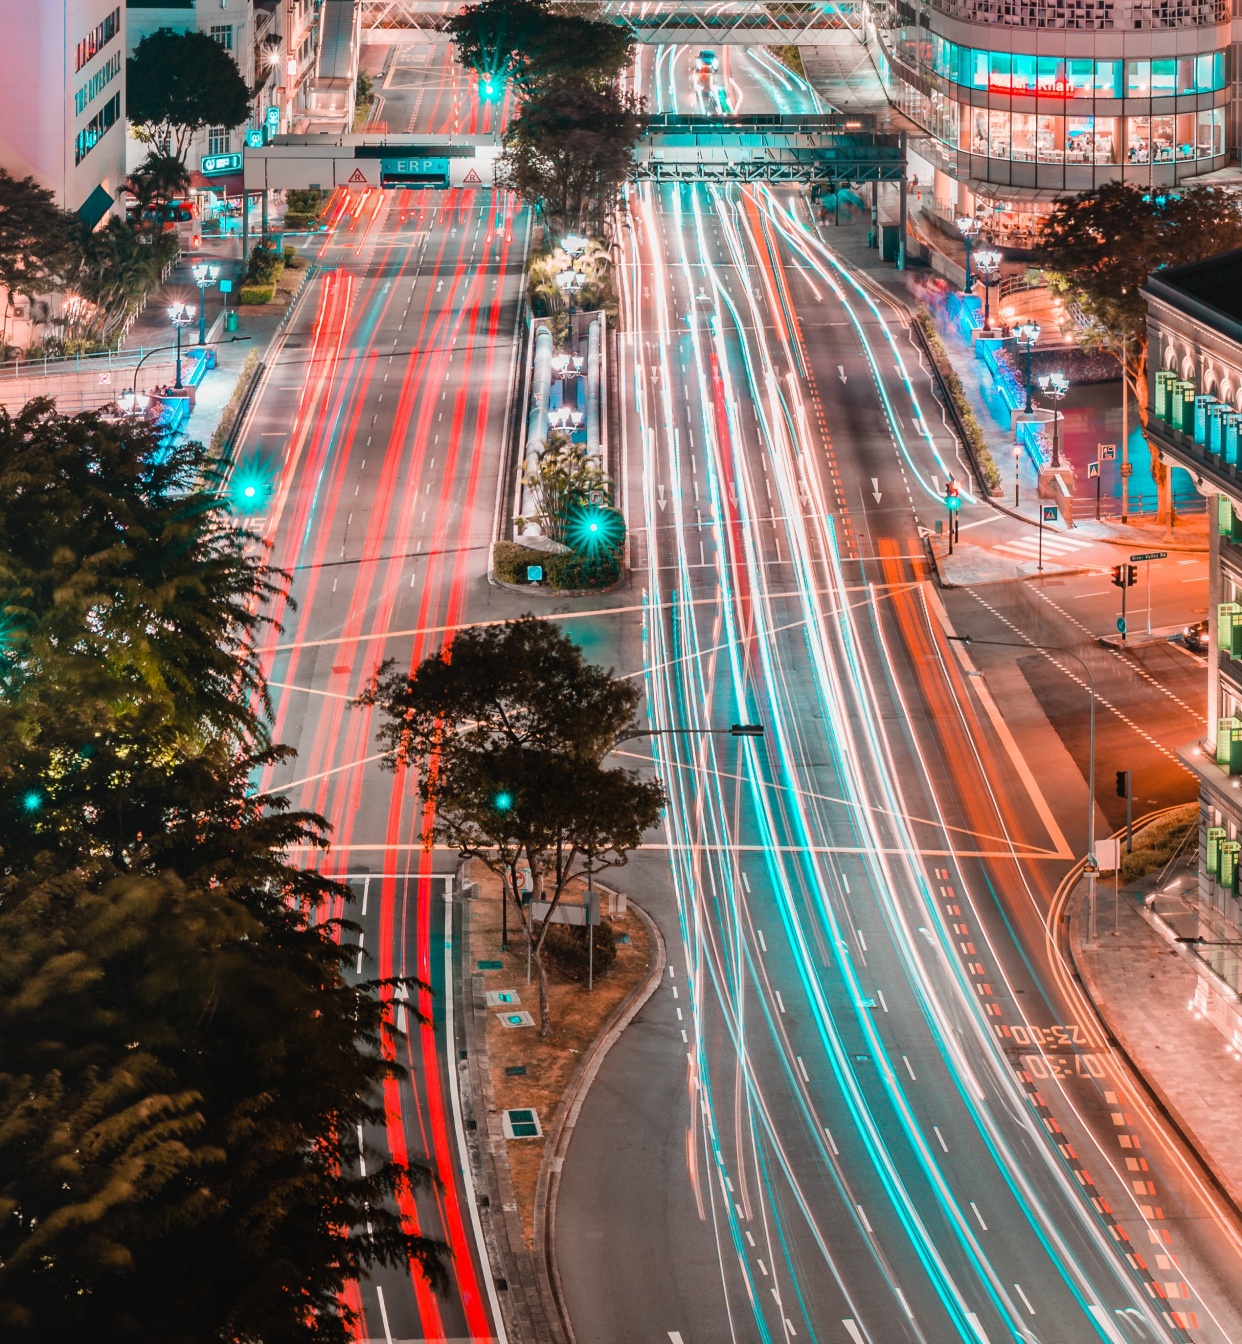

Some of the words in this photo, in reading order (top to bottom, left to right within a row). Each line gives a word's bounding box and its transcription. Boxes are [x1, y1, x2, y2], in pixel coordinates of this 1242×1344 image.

[75, 83, 87, 118] THE
[88, 49, 121, 103] RIVERWALK
[397, 160, 433, 172] ERP
[1025, 1055, 1107, 1079] 07:30
